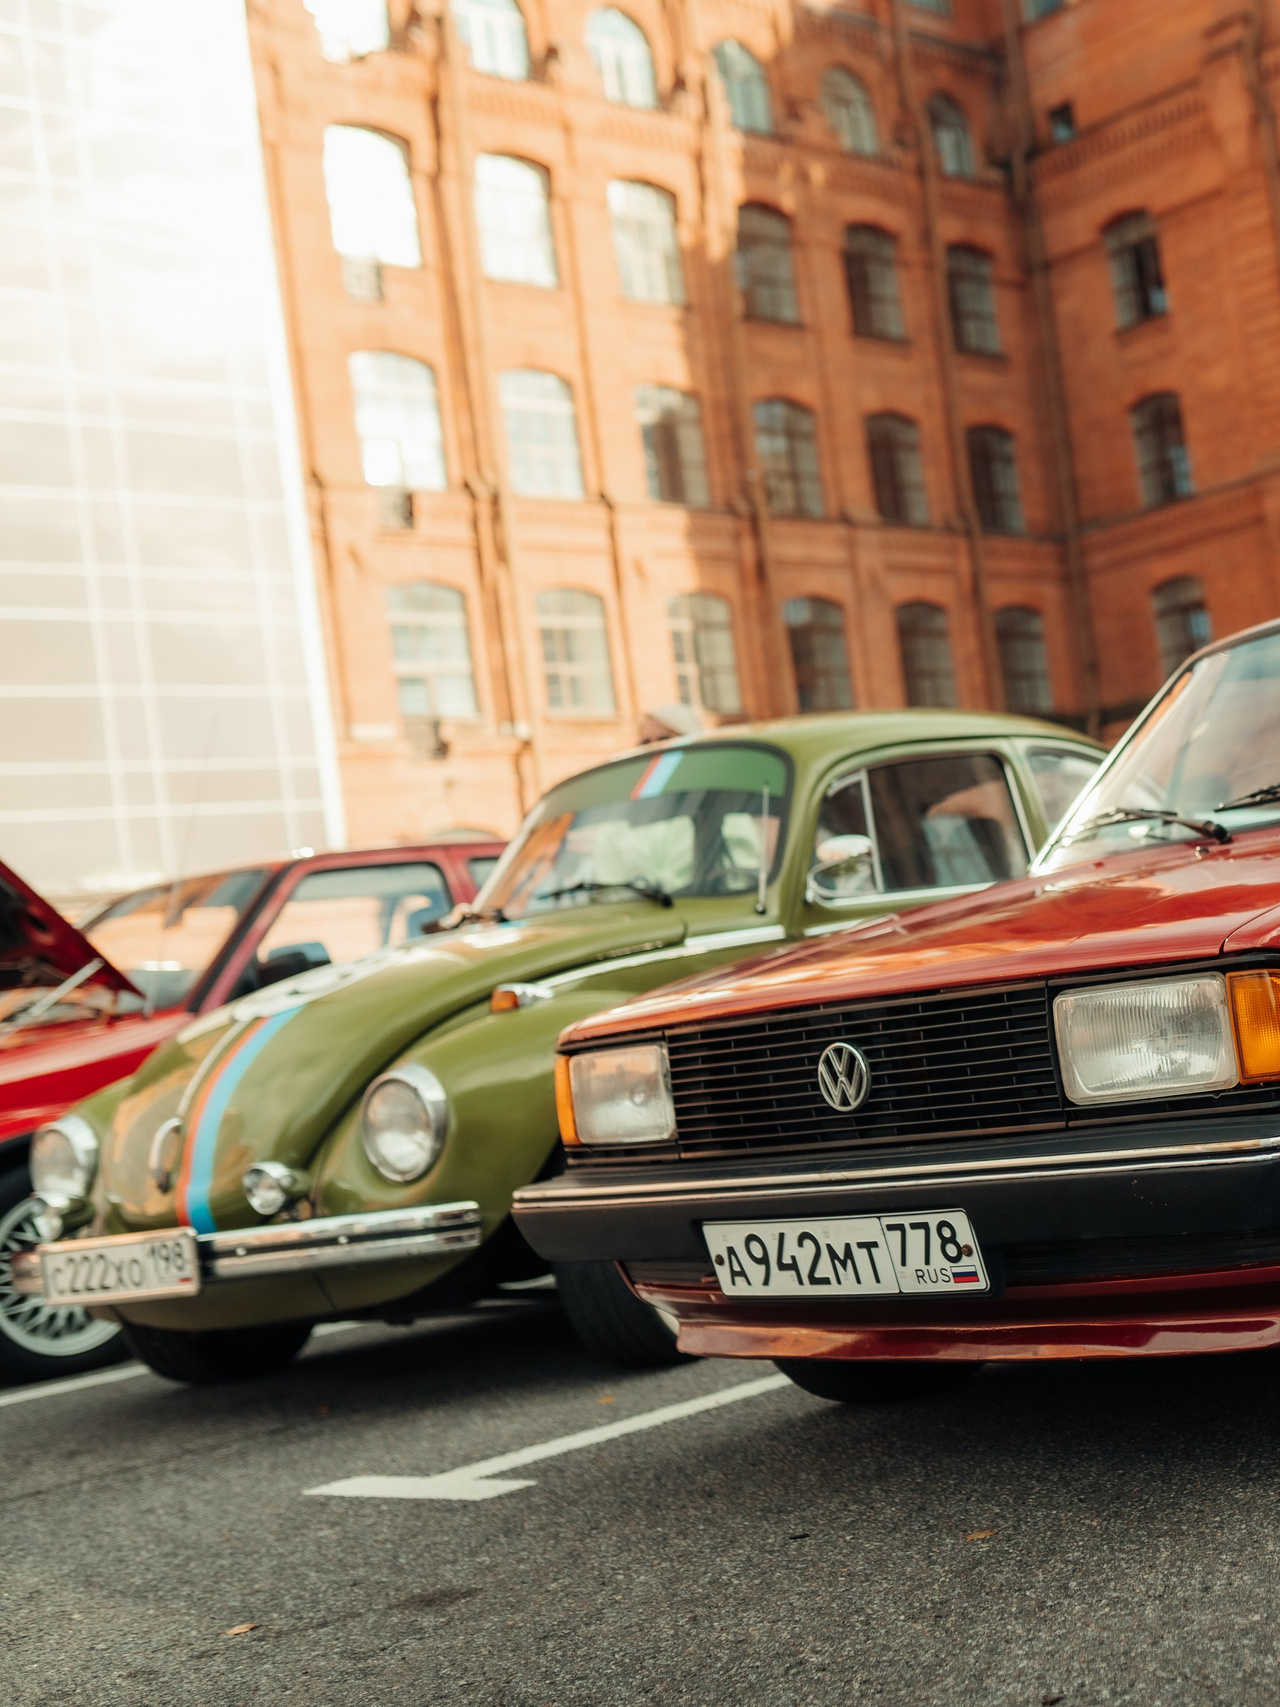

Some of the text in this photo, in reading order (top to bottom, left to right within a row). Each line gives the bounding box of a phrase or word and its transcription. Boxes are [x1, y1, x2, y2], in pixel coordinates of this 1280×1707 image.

[149, 1242, 186, 1272] 198
[885, 1219, 962, 1267] 778
[914, 1267, 951, 1285] RUS
